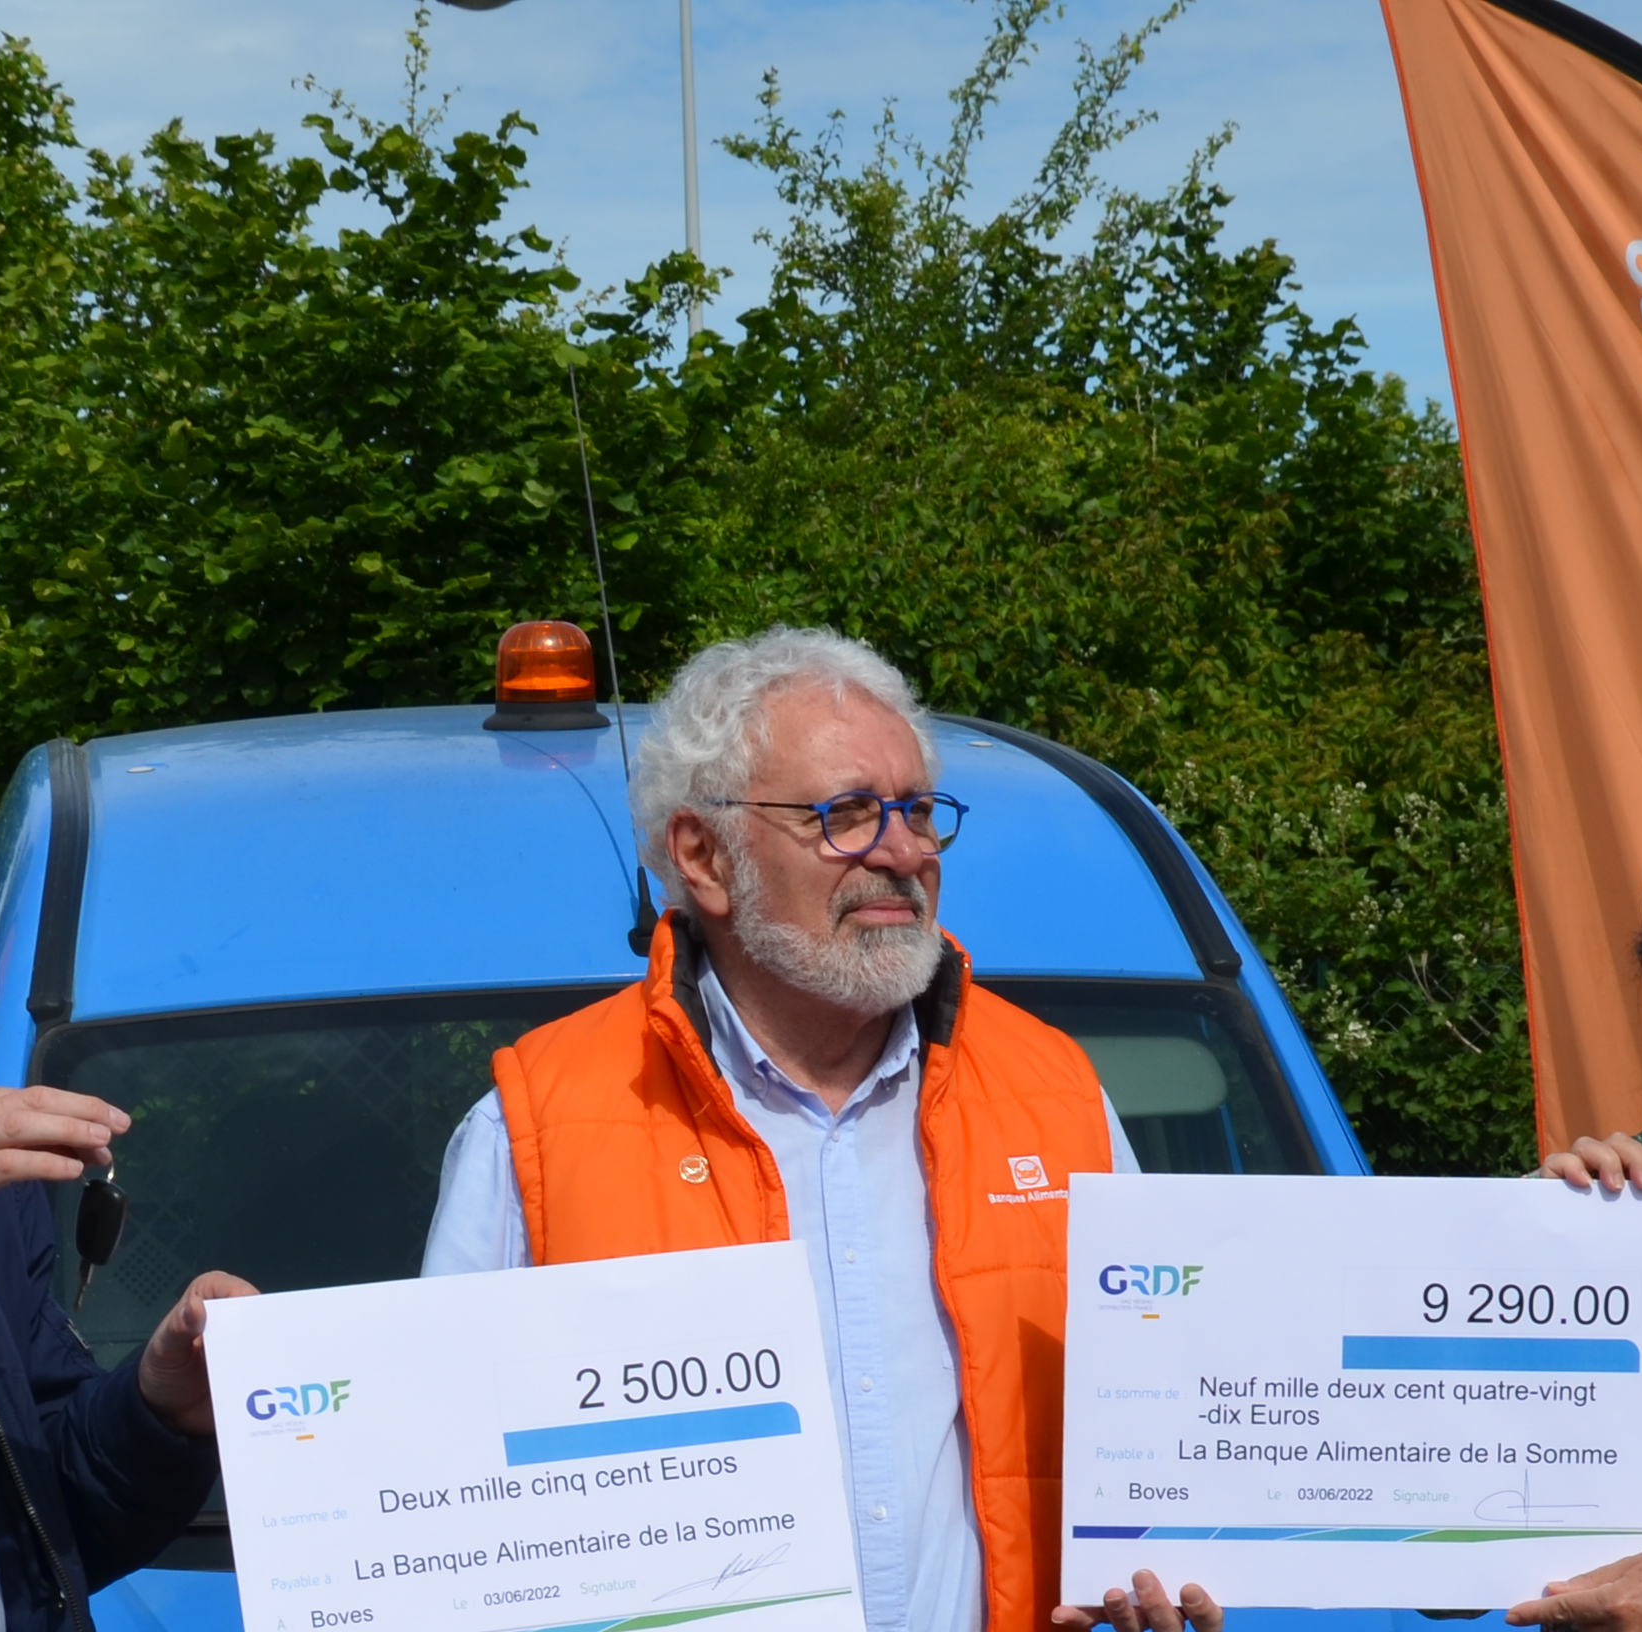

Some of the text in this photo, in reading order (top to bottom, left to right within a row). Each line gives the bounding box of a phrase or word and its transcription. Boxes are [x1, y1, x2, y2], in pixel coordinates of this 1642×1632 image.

[1098, 1264, 1205, 1297] GRDF
[1466, 1283, 1632, 1326] 290.00
[621, 1348, 783, 1405] 500.00
[245, 1379, 352, 1421] GRDF
[1096, 1387, 1111, 1399] La
[1115, 1389, 1161, 1400] somme
[1165, 1388, 1180, 1400] de
[1199, 1376, 1597, 1407] Neuf mille deux cent quatre-vingt
[1198, 1404, 1321, 1426] -dix Euros
[1095, 1447, 1144, 1462] Payable
[1178, 1439, 1619, 1466] La Banque Alimentaire de la Somme
[378, 1454, 739, 1514] Deux mille cinq cent Euros
[1128, 1482, 1189, 1501] Boves
[1267, 1488, 1282, 1501] Le
[1297, 1487, 1374, 1502] 03/06/2022
[1393, 1489, 1450, 1505] Signature
[262, 1515, 278, 1529] La
[281, 1511, 329, 1527] somme
[332, 1508, 348, 1521] de
[354, 1513, 796, 1581] La Banque Alimentaire de la Somme
[271, 1573, 320, 1592] Payable
[579, 1578, 637, 1597] Signature
[452, 1598, 468, 1611] Le
[483, 1585, 561, 1607] 03/06/2022
[310, 1607, 375, 1629] Boves
